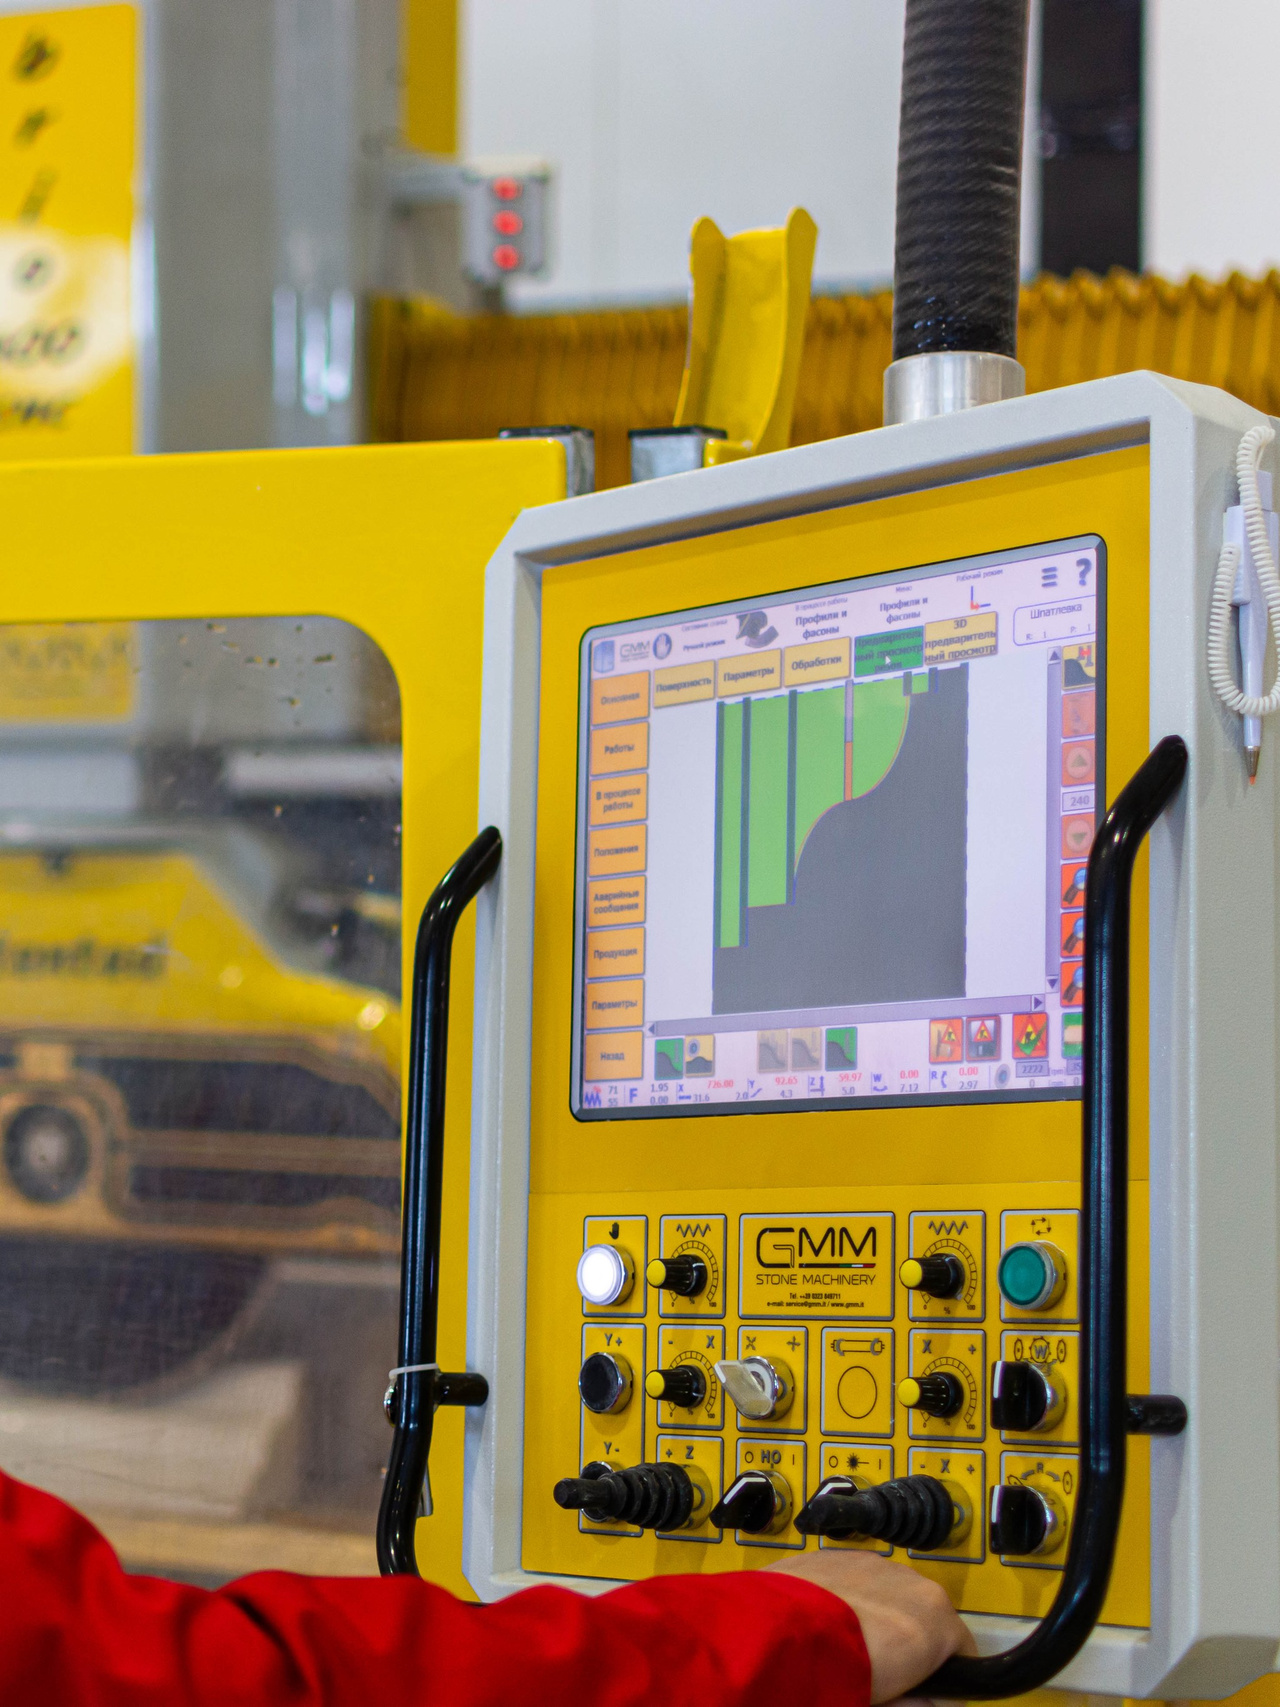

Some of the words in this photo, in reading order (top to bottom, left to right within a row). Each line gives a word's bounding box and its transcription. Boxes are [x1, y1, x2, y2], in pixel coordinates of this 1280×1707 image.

[880, 600, 920, 612] Профили
[1030, 603, 1083, 619] Шпатлевка
[795, 612, 839, 627] Профили
[886, 611, 921, 624] фасоны
[953, 619, 968, 630] 3D
[803, 626, 840, 640] фасоны
[925, 631, 996, 650] предваритель
[925, 651, 945, 662] ный
[948, 645, 996, 660] просмотр
[792, 655, 842, 671] Обработки
[723, 667, 775, 682] Параметры
[656, 677, 711, 694] Поверхность
[604, 744, 635, 754] Работы
[604, 787, 641, 800] процессе
[1070, 795, 1090, 806] 240
[603, 803, 633, 814] работы
[594, 889, 639, 902] Аварийные
[594, 902, 639, 914] сообщения
[594, 948, 638, 960] Продукция
[592, 1000, 638, 1011] Параметры
[900, 1070, 919, 1079] 0.00
[931, 1071, 937, 1079] R
[959, 1067, 978, 1076] 0.00
[775, 1075, 798, 1085] 92.65
[873, 1074, 882, 1082] W
[650, 1083, 669, 1093] 1.95
[842, 1086, 855, 1095] 5.0
[900, 1083, 919, 1093] 7.12
[959, 1080, 978, 1090] 2.97
[629, 1087, 638, 1103] F
[650, 1095, 669, 1105] 0.00
[756, 1226, 877, 1268] GMM
[756, 1274, 797, 1286] STONE
[802, 1274, 876, 1286] MACHINERY
[831, 1301, 865, 1309] www.gmm.it
[706, 1335, 715, 1349] X
[922, 1340, 932, 1354] X
[1034, 1345, 1048, 1359] W
[685, 1446, 694, 1459] Z
[940, 1459, 950, 1473] X
[1036, 1462, 1044, 1473] R
